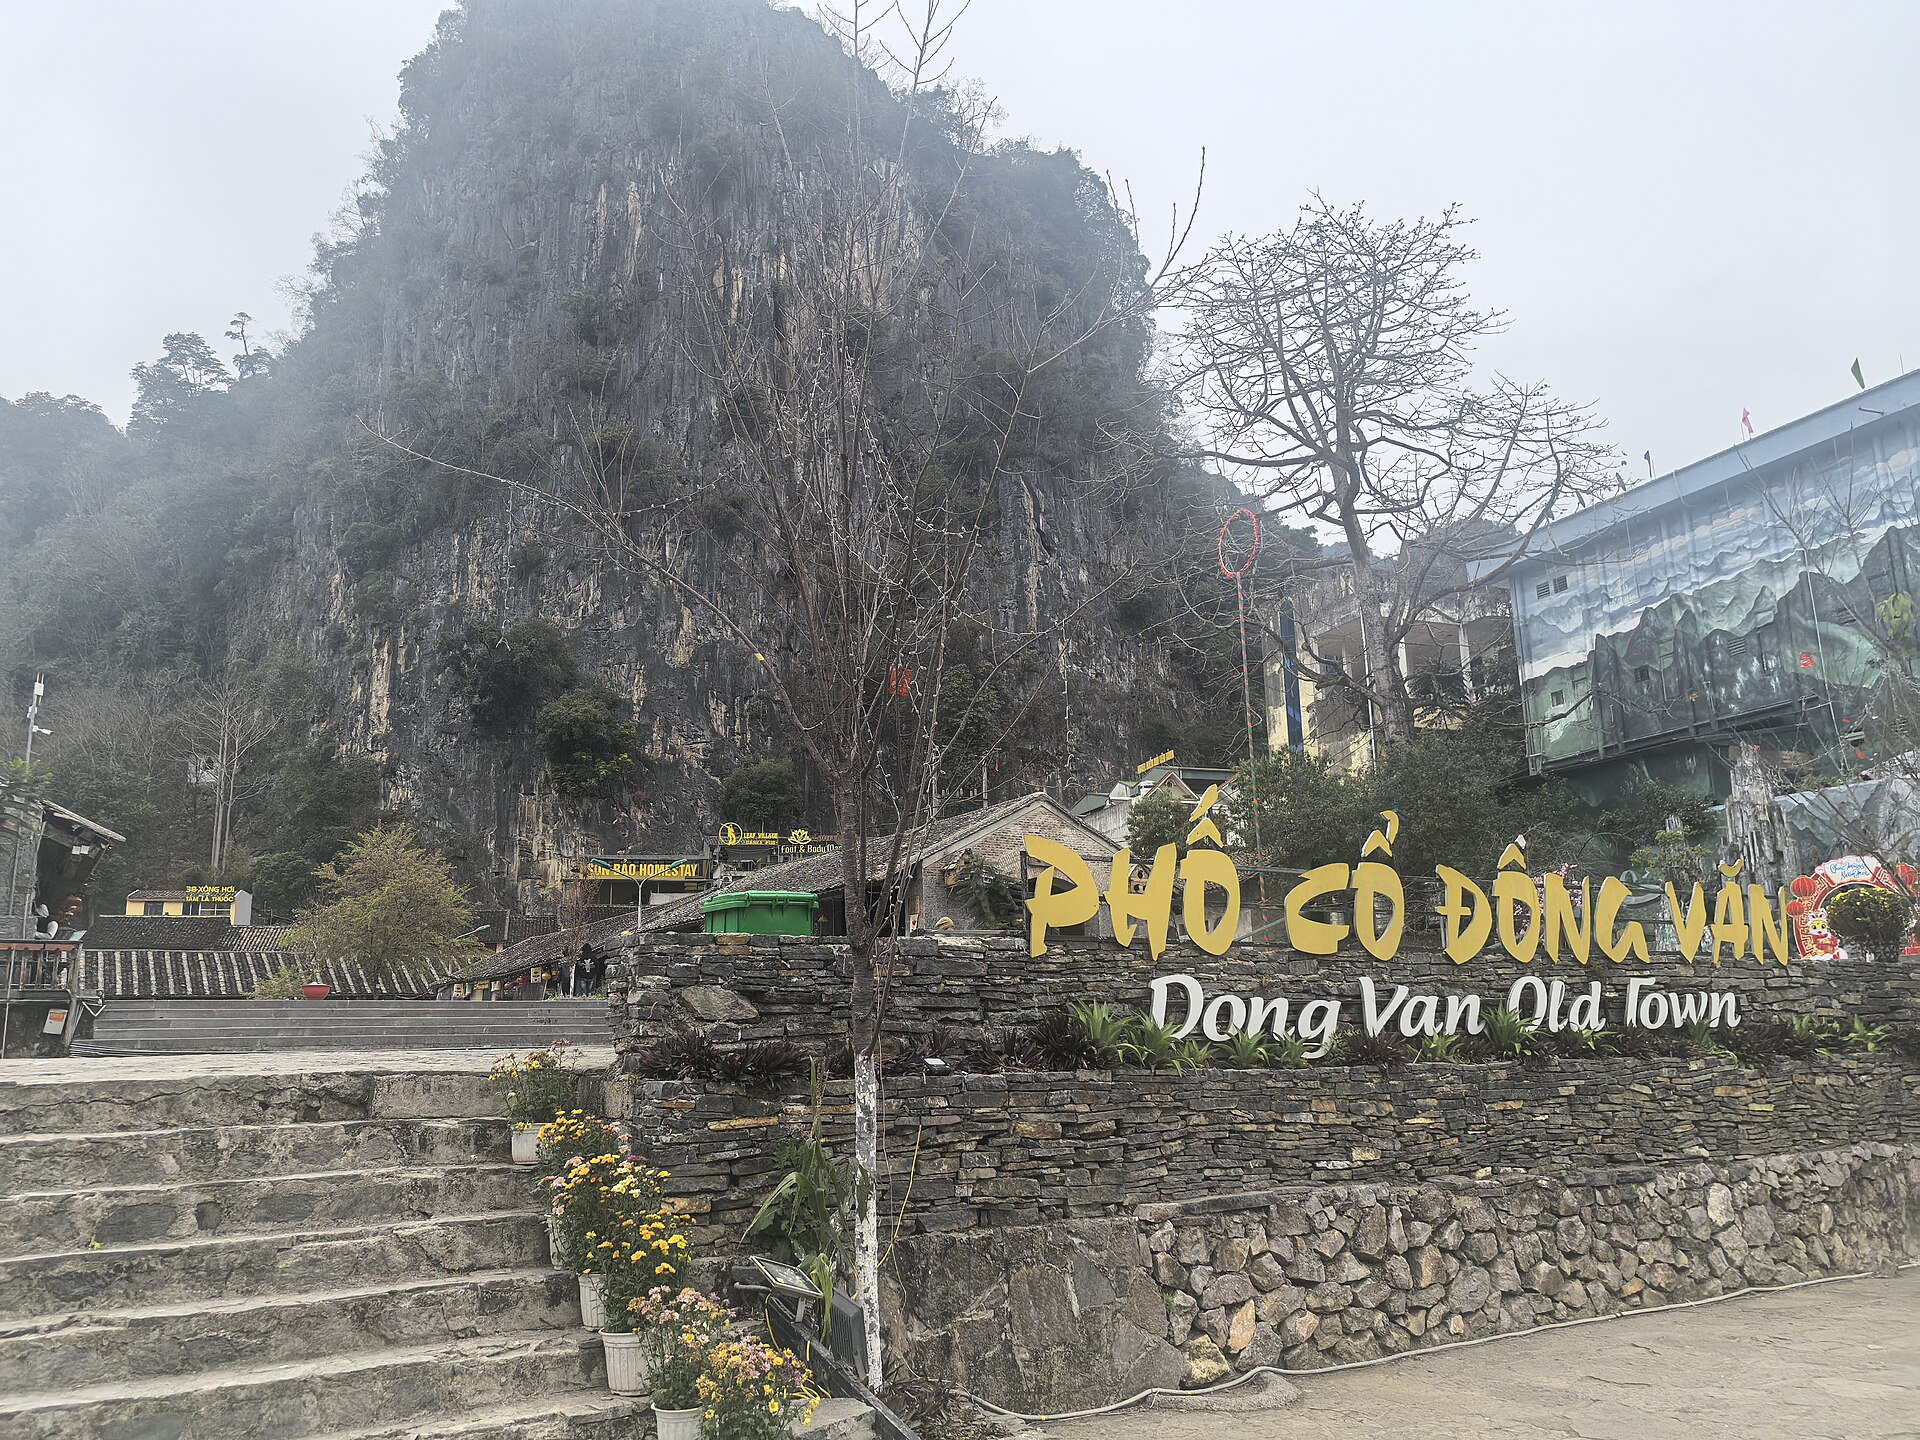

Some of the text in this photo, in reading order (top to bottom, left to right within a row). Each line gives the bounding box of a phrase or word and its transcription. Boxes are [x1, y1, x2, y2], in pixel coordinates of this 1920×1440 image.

[640, 863, 698, 876] HOMESTAY
[781, 845, 797, 853] Foot
[799, 845, 805, 853] &
[1023, 783, 1241, 961] PHỐ
[1284, 810, 1404, 961] CỔ
[1665, 858, 1788, 966] VĂN
[1150, 974, 1742, 1059] Dong Van Old Town
